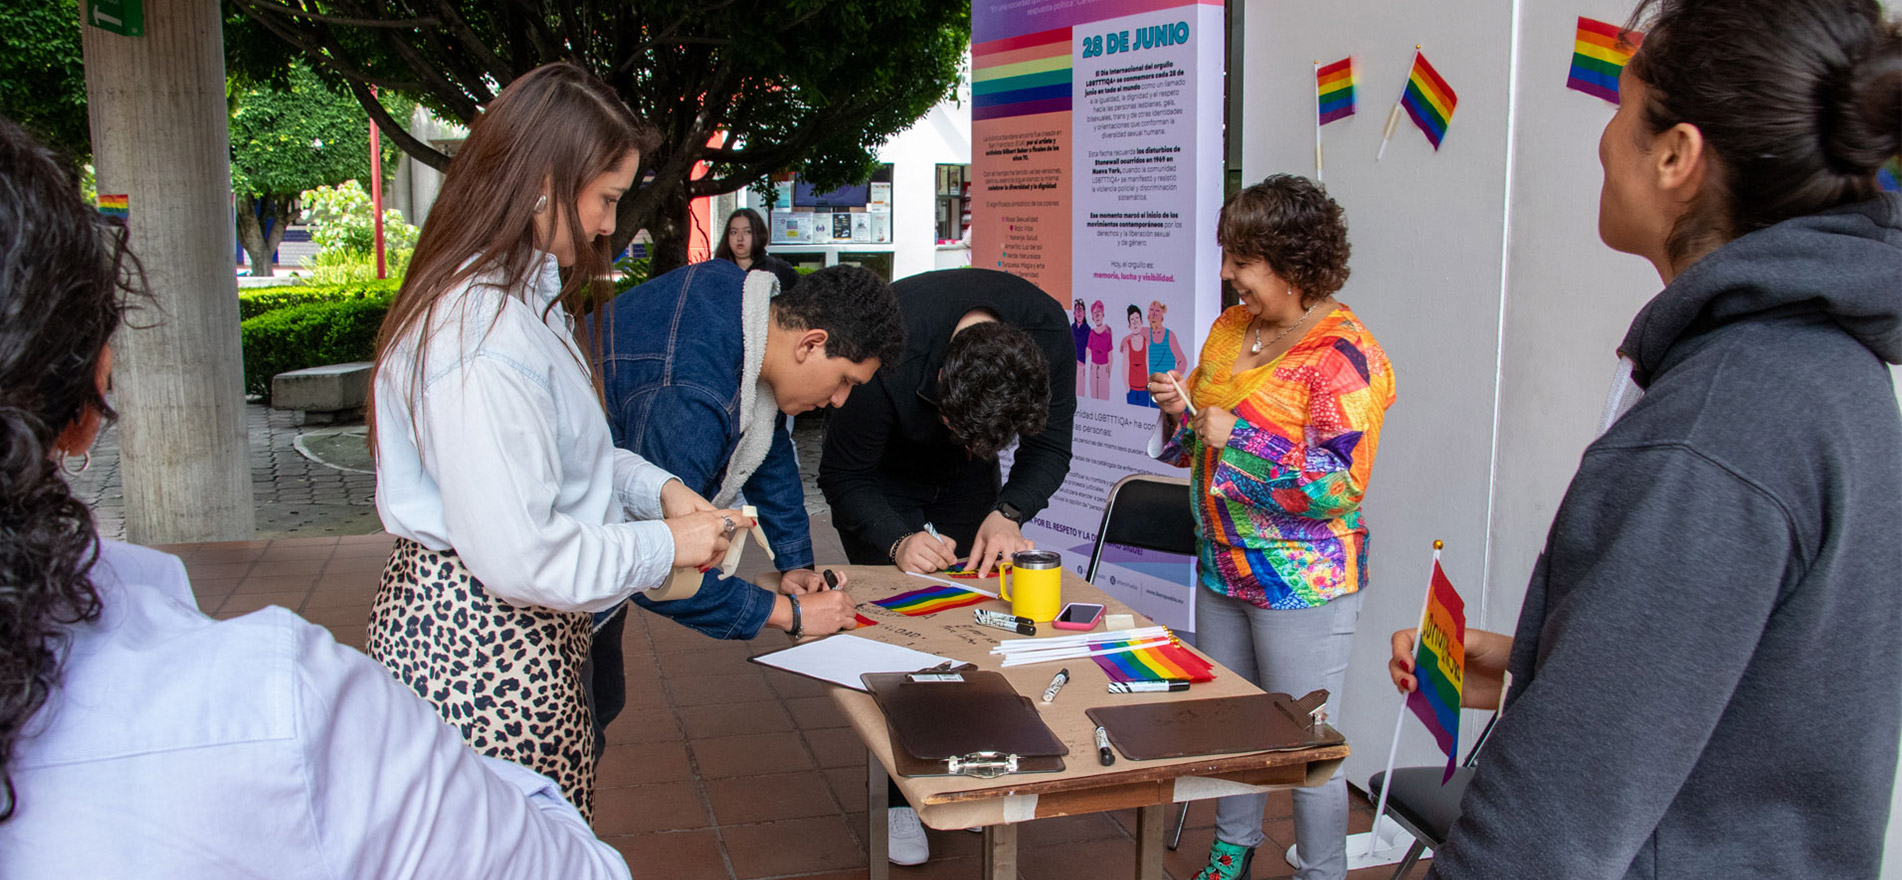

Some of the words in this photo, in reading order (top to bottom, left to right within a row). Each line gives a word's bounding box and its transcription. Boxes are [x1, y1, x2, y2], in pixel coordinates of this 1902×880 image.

[1082, 37, 1103, 59] 28
[1107, 30, 1129, 55] DE
[1133, 21, 1190, 51] JUNIO
[1145, 63, 1153, 71] del
[1154, 61, 1173, 70] orgullo
[1085, 88, 1097, 98] junio
[1121, 272, 1137, 280] lucha
[1138, 274, 1142, 282] y
[1134, 419, 1142, 429] ha
[1034, 517, 1045, 526] POR
[1045, 520, 1052, 529] EL
[1053, 522, 1078, 536] RESPETO
[1078, 529, 1082, 537] Y
[1083, 531, 1090, 540] LA
